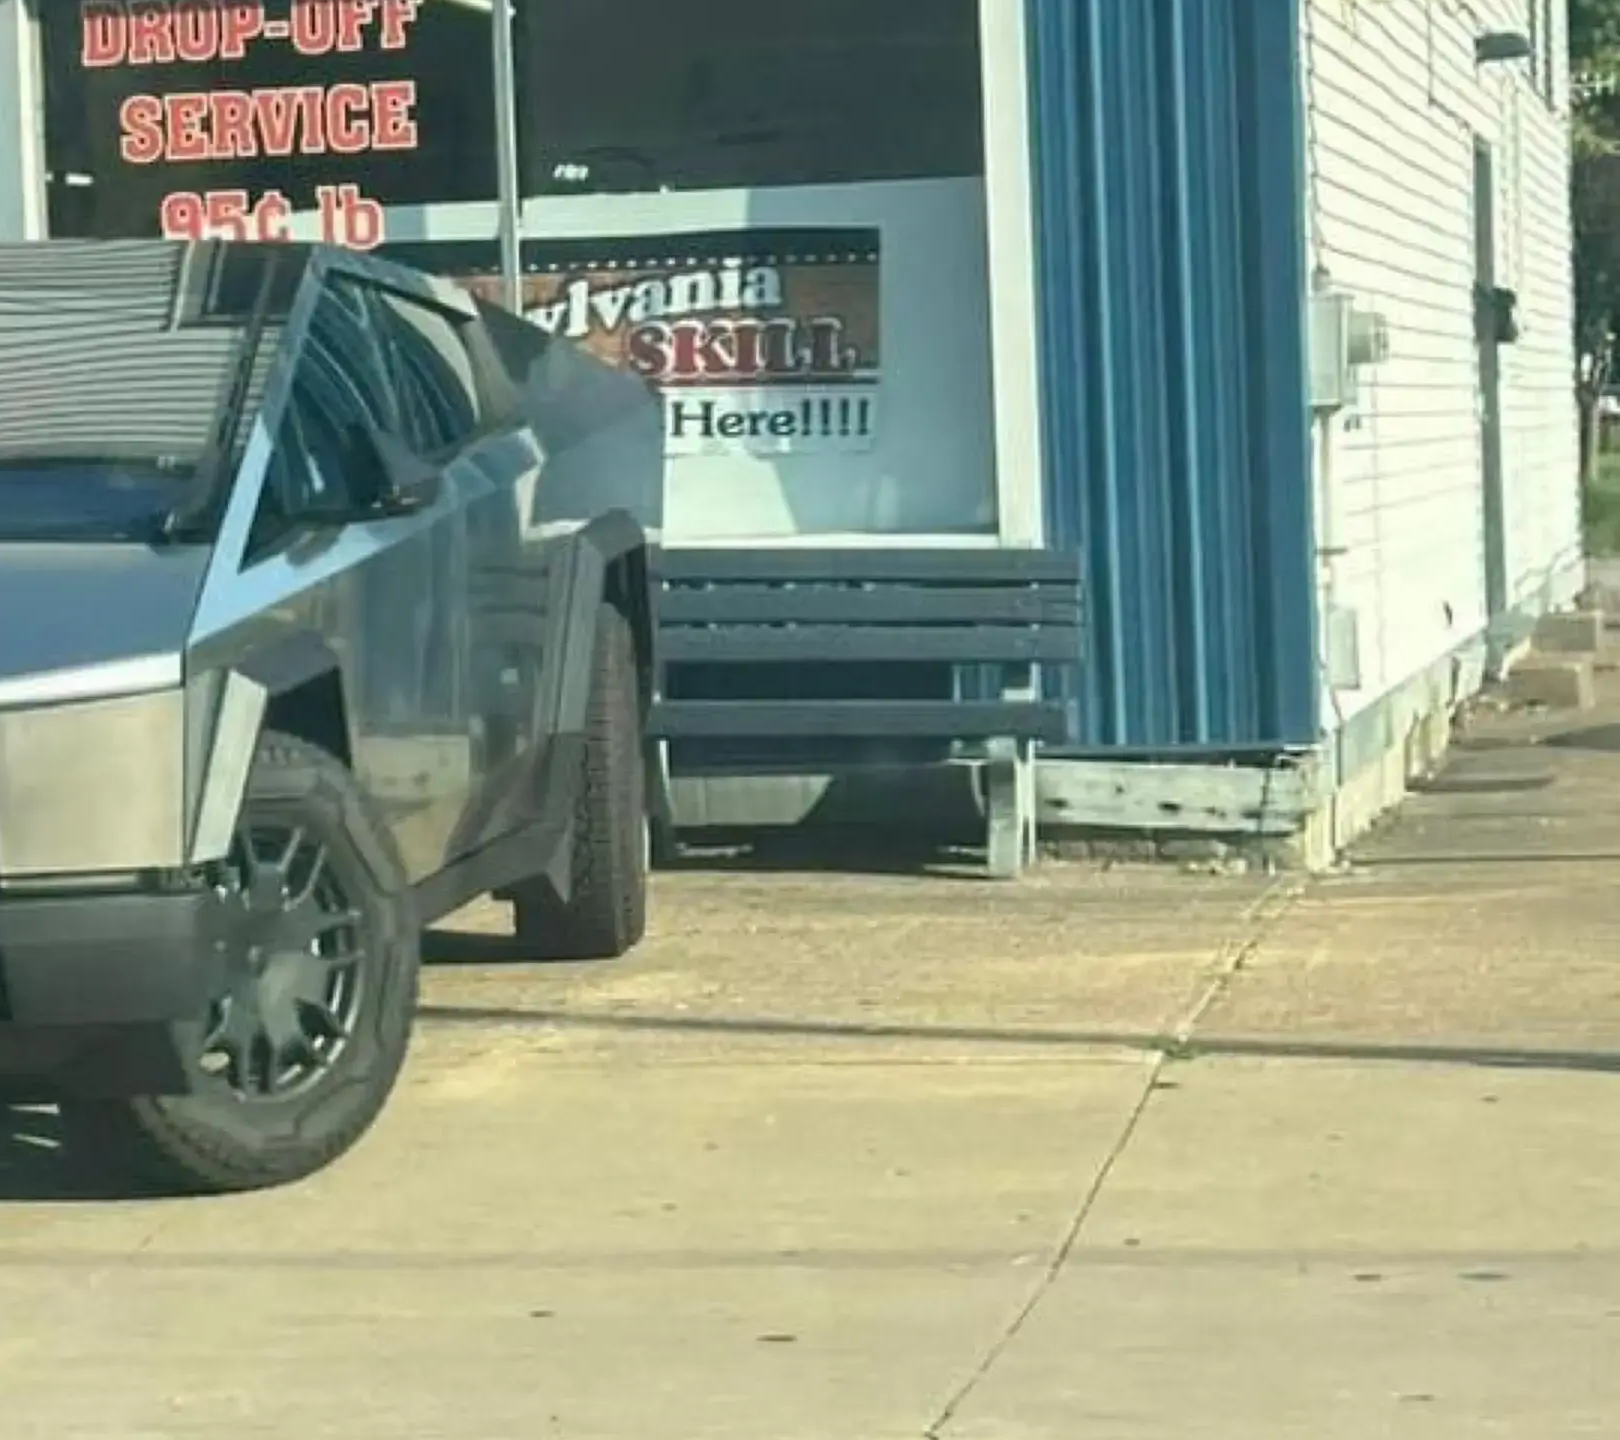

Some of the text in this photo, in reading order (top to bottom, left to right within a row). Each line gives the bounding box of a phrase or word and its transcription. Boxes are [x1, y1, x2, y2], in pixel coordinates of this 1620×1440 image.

[120, 80, 418, 162] SERVICE
[315, 183, 385, 249] lb
[629, 317, 862, 381] SKILL
[670, 397, 870, 438] Here!!!!
